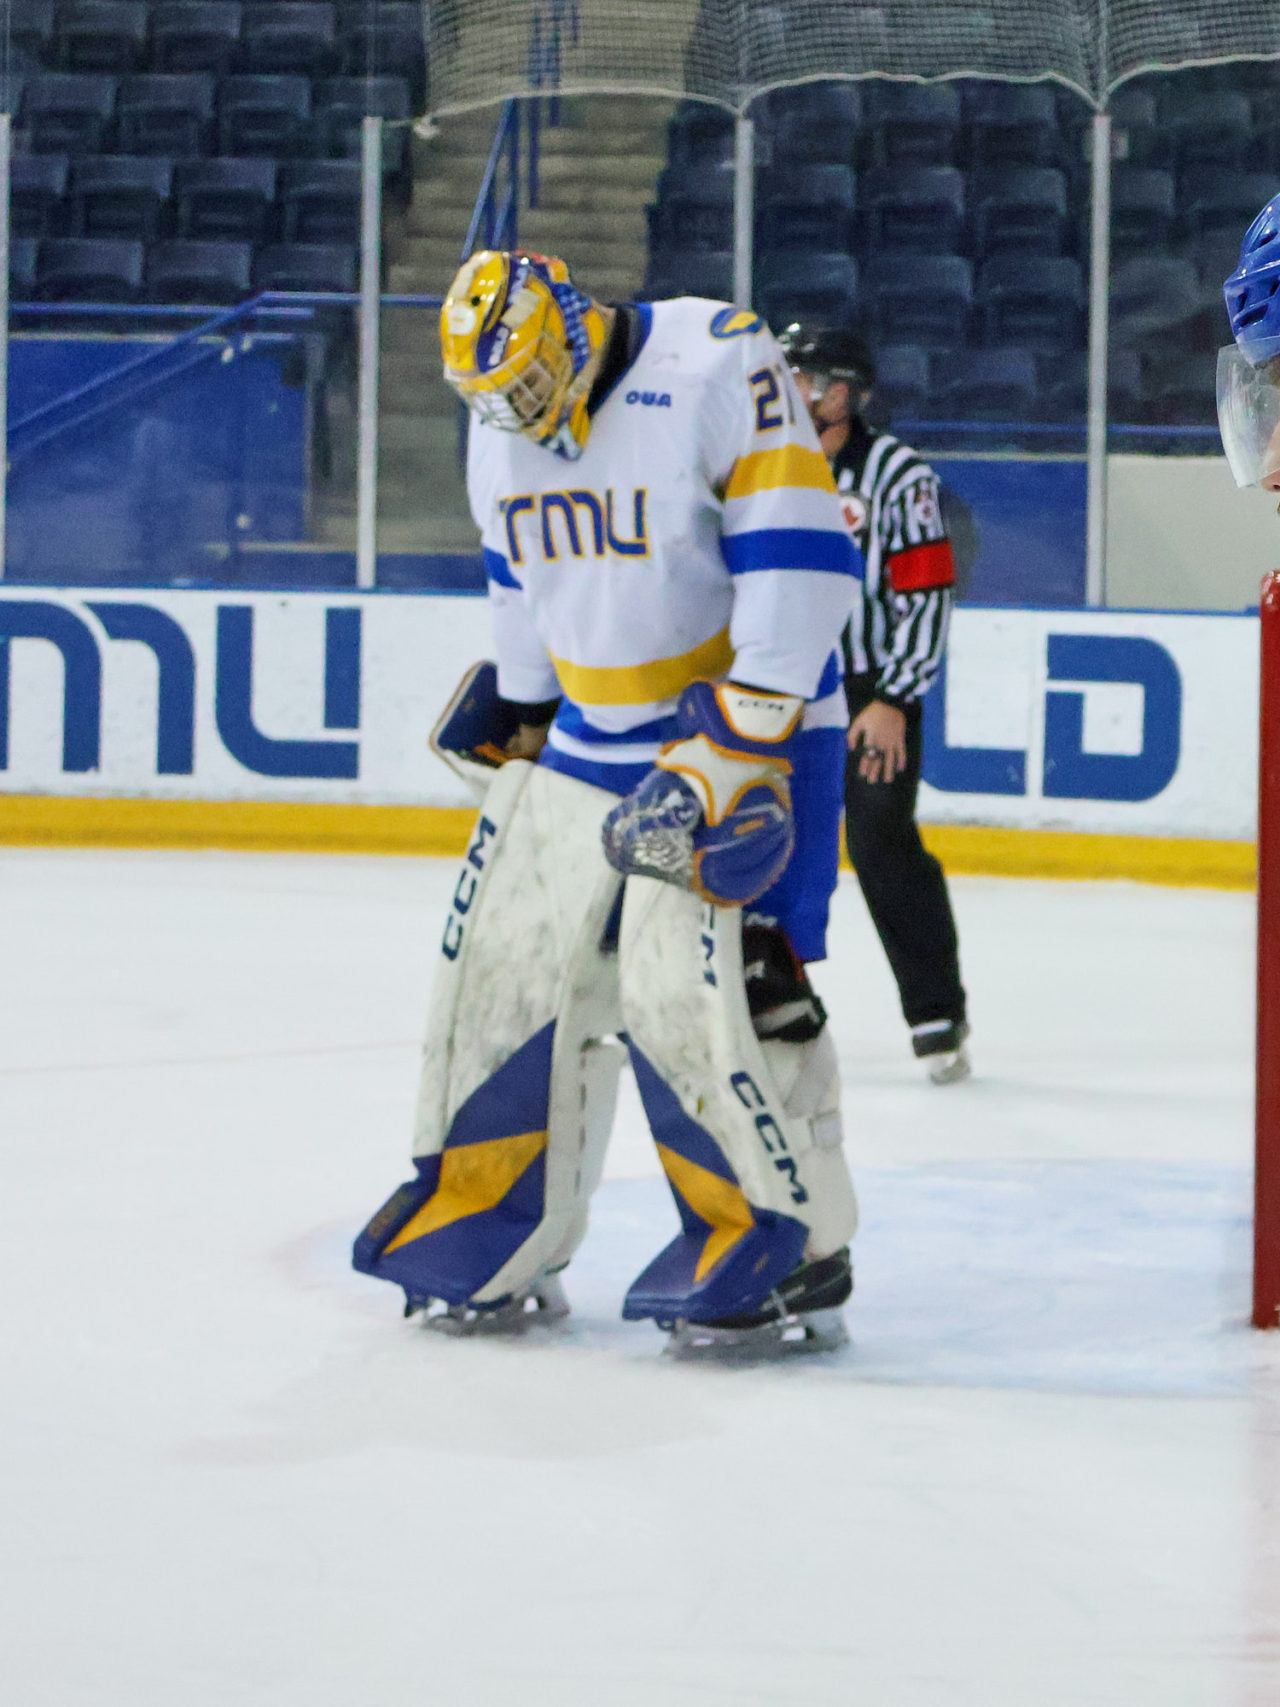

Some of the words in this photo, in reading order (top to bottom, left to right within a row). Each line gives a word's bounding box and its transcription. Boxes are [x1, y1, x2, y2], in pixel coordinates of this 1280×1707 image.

[625, 390, 672, 409] OUA
[498, 487, 650, 568] TMU
[441, 815, 497, 962] CCM
[730, 1070, 809, 1206] CCM
